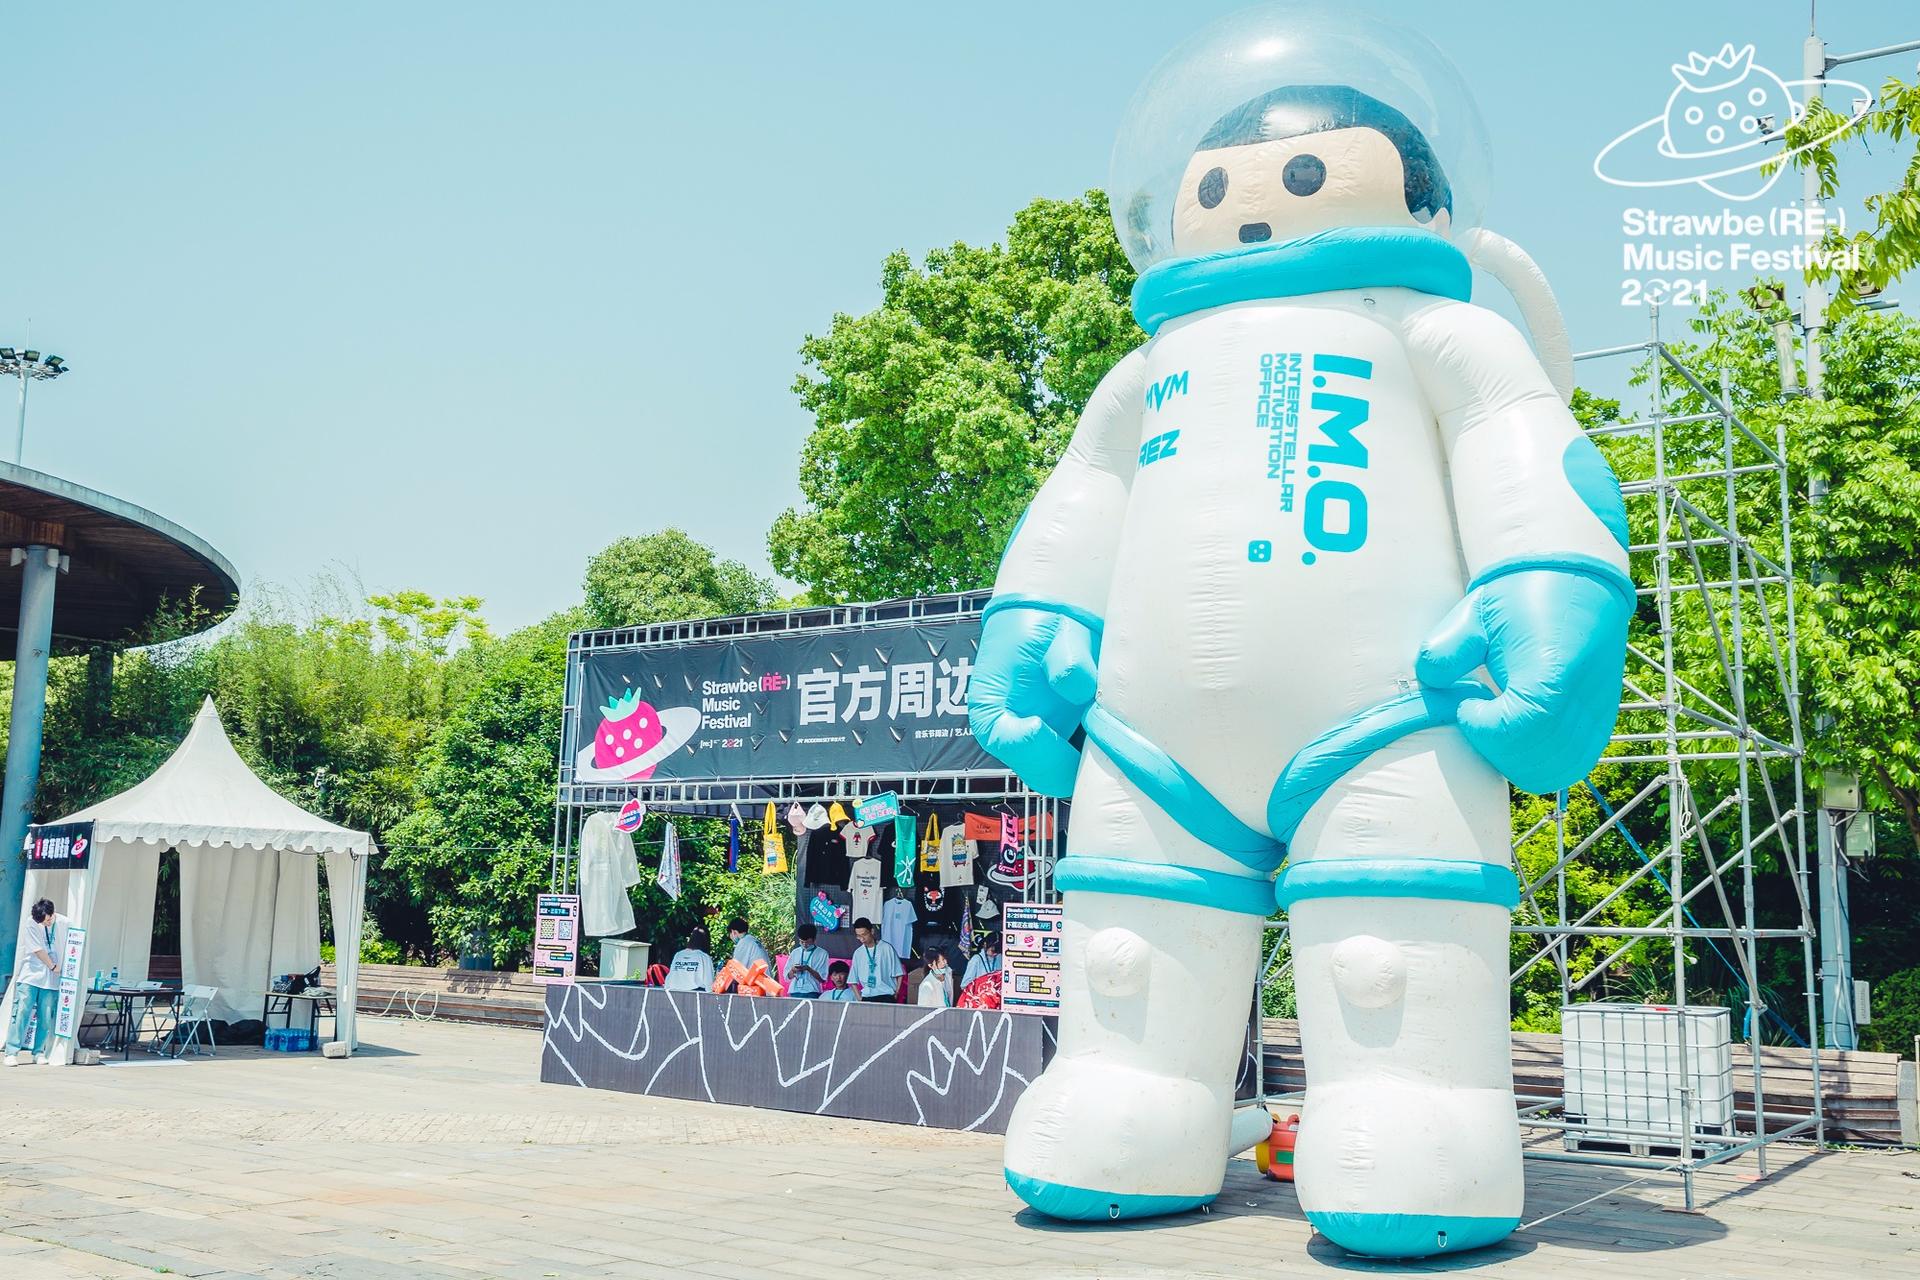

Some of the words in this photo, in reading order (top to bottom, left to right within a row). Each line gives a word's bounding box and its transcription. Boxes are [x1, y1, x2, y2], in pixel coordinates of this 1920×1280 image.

[1256, 353, 1273, 428] OFFICE
[1267, 353, 1288, 479] MOTIVATION
[1280, 353, 1302, 512] INTERSTELLAR
[1302, 353, 1373, 566] I.M.O.
[701, 713, 752, 730] Festival
[702, 679, 757, 696] Strawbe
[702, 697, 740, 713] Music
